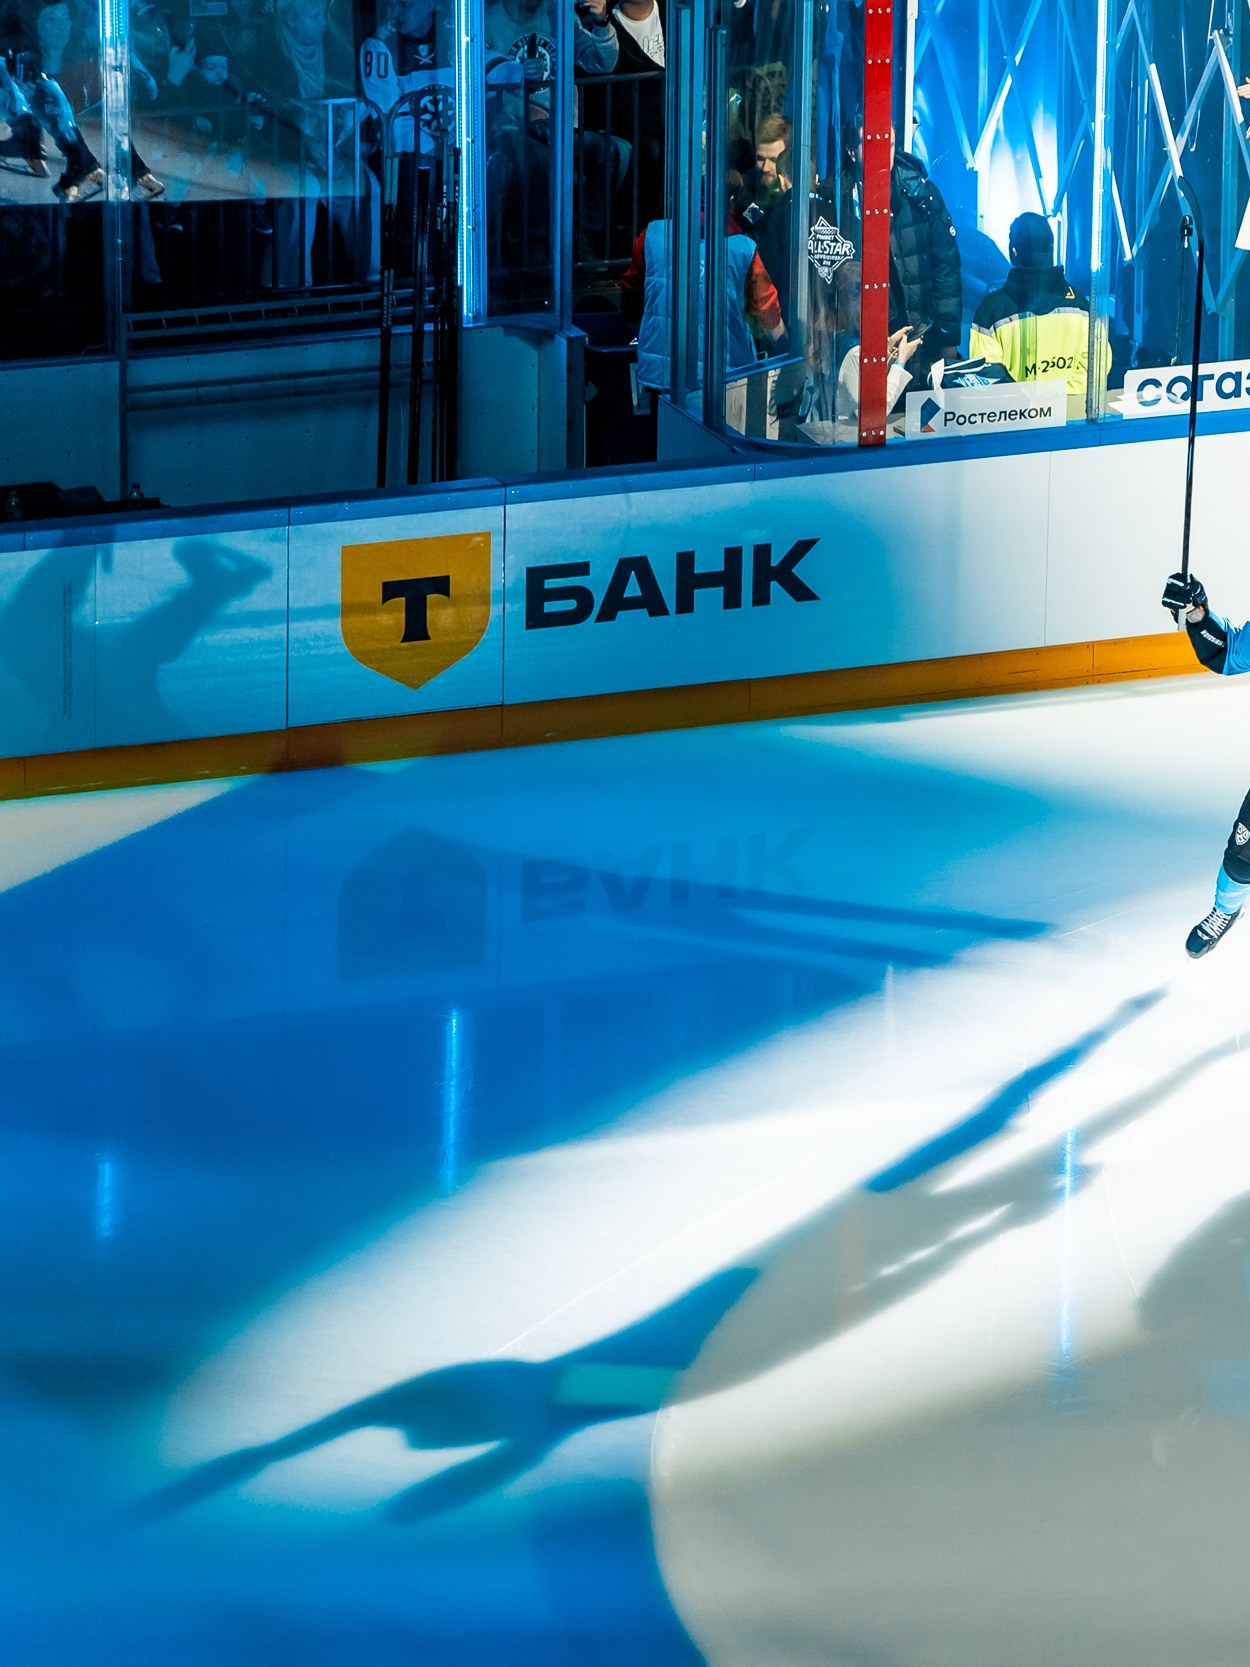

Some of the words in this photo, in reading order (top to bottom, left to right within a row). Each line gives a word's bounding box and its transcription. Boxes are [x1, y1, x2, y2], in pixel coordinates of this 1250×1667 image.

[364, 50, 389, 79] 80
[943, 406, 1052, 428] Ростелеком
[381, 574, 451, 644] Т
[524, 537, 821, 631] БАНК
